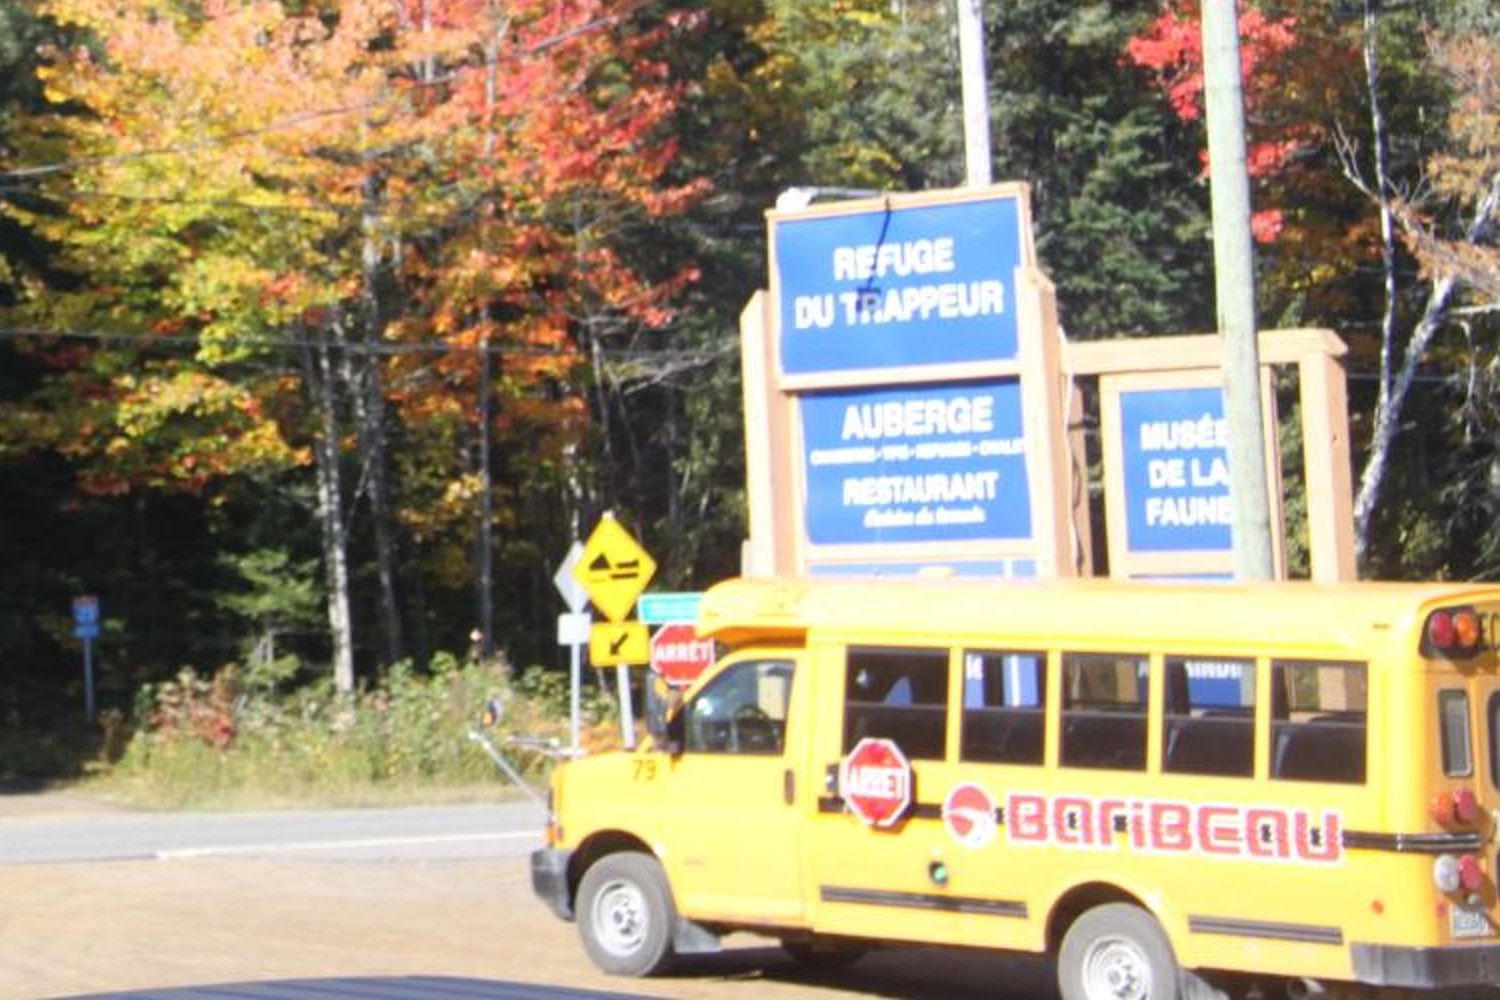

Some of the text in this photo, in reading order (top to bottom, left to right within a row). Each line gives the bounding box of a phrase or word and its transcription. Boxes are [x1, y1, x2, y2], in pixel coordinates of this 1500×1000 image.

[834, 236, 955, 281] REFUGE
[795, 280, 1004, 329] DU TRAPPEUR
[841, 396, 994, 440] AUBERGE
[843, 471, 999, 507] RESTAURANT
[1148, 457, 1230, 488] DE LA
[1145, 495, 1234, 527] FAUNE
